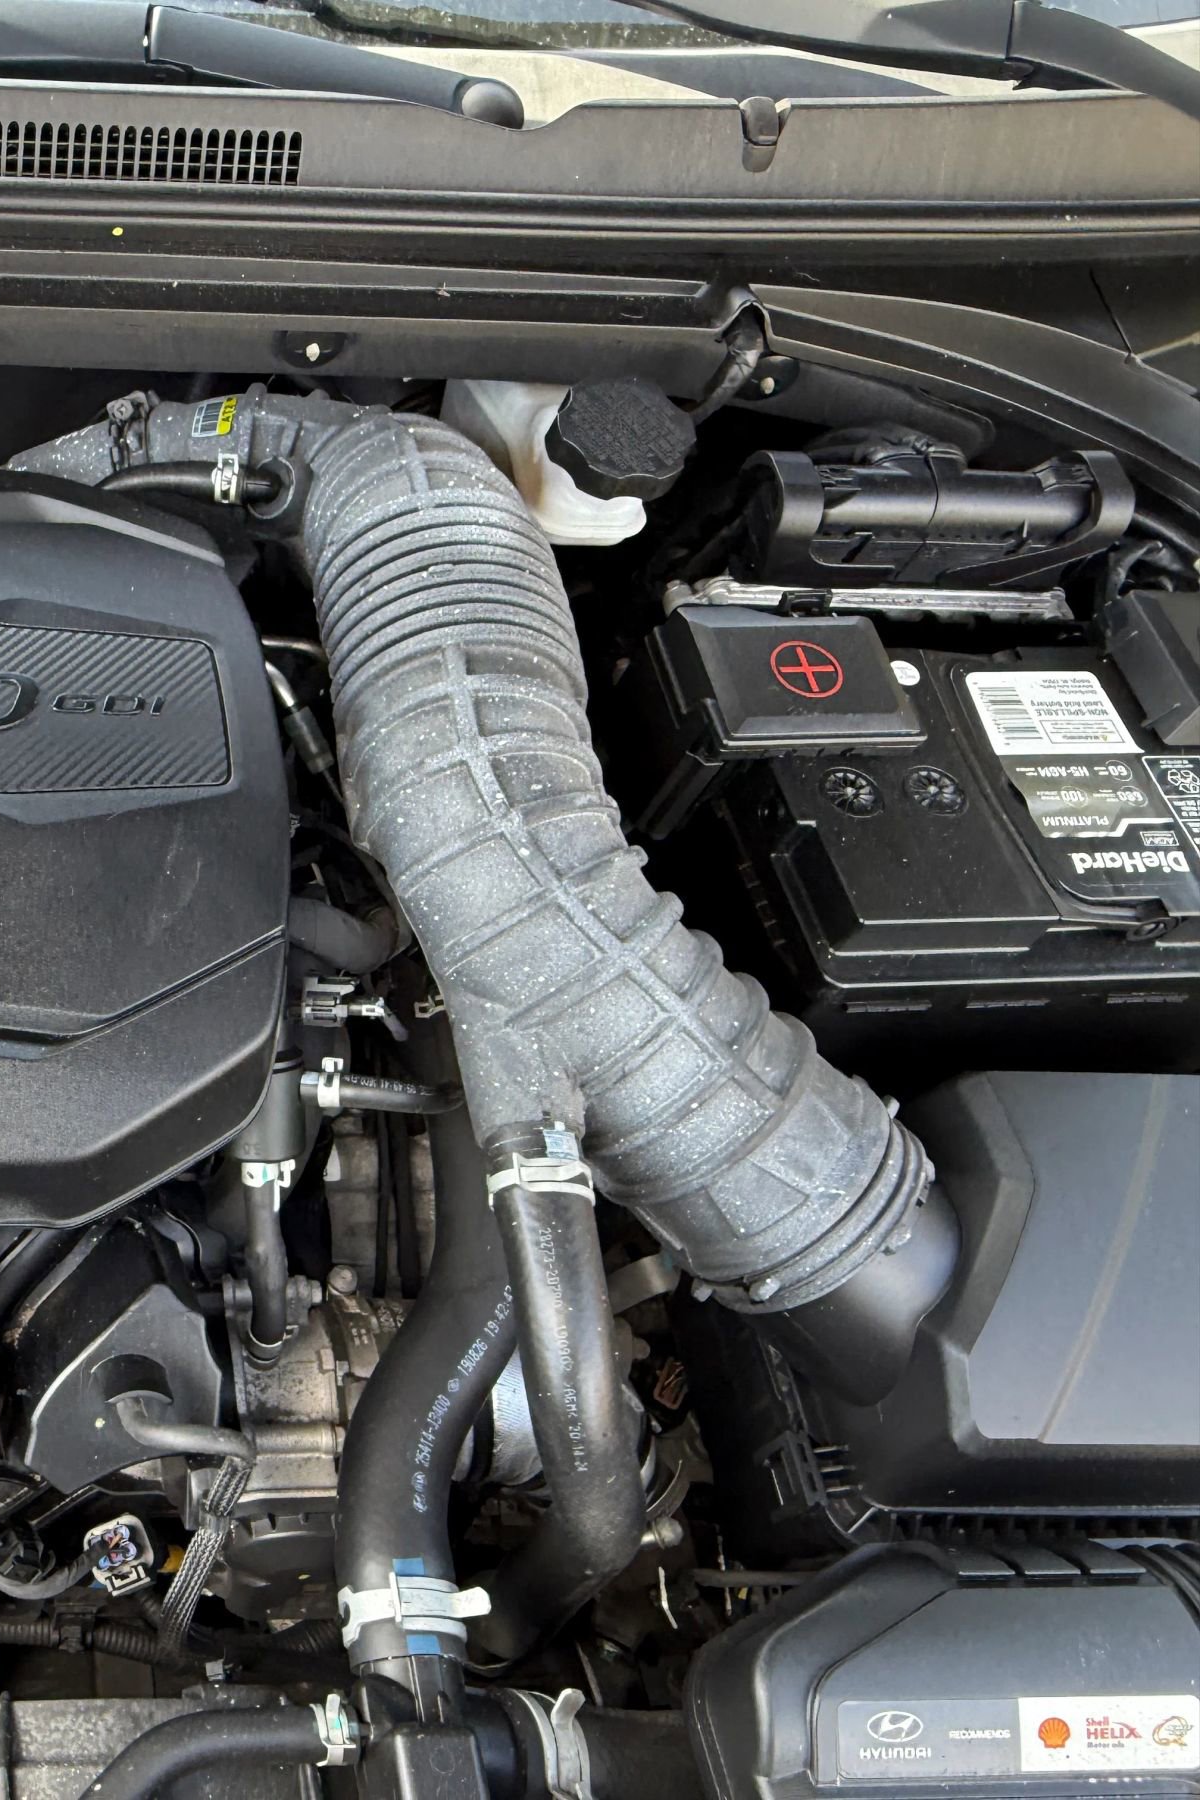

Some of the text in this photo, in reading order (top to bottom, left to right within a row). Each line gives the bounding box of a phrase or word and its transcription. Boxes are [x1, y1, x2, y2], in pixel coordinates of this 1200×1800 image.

[50, 691, 167, 719] GDI
[1030, 699, 1063, 708] Battery
[1061, 790, 1085, 801] 100
[1042, 815, 1109, 826] PLATINUM
[1071, 850, 1190, 874] DieHard
[457, 1338, 487, 1378] 190826
[1085, 1716, 1110, 1727] Shell
[1086, 1726, 1143, 1740] HELIX
[860, 1728, 1012, 1760] HYUNDAI RECOMMENDS
